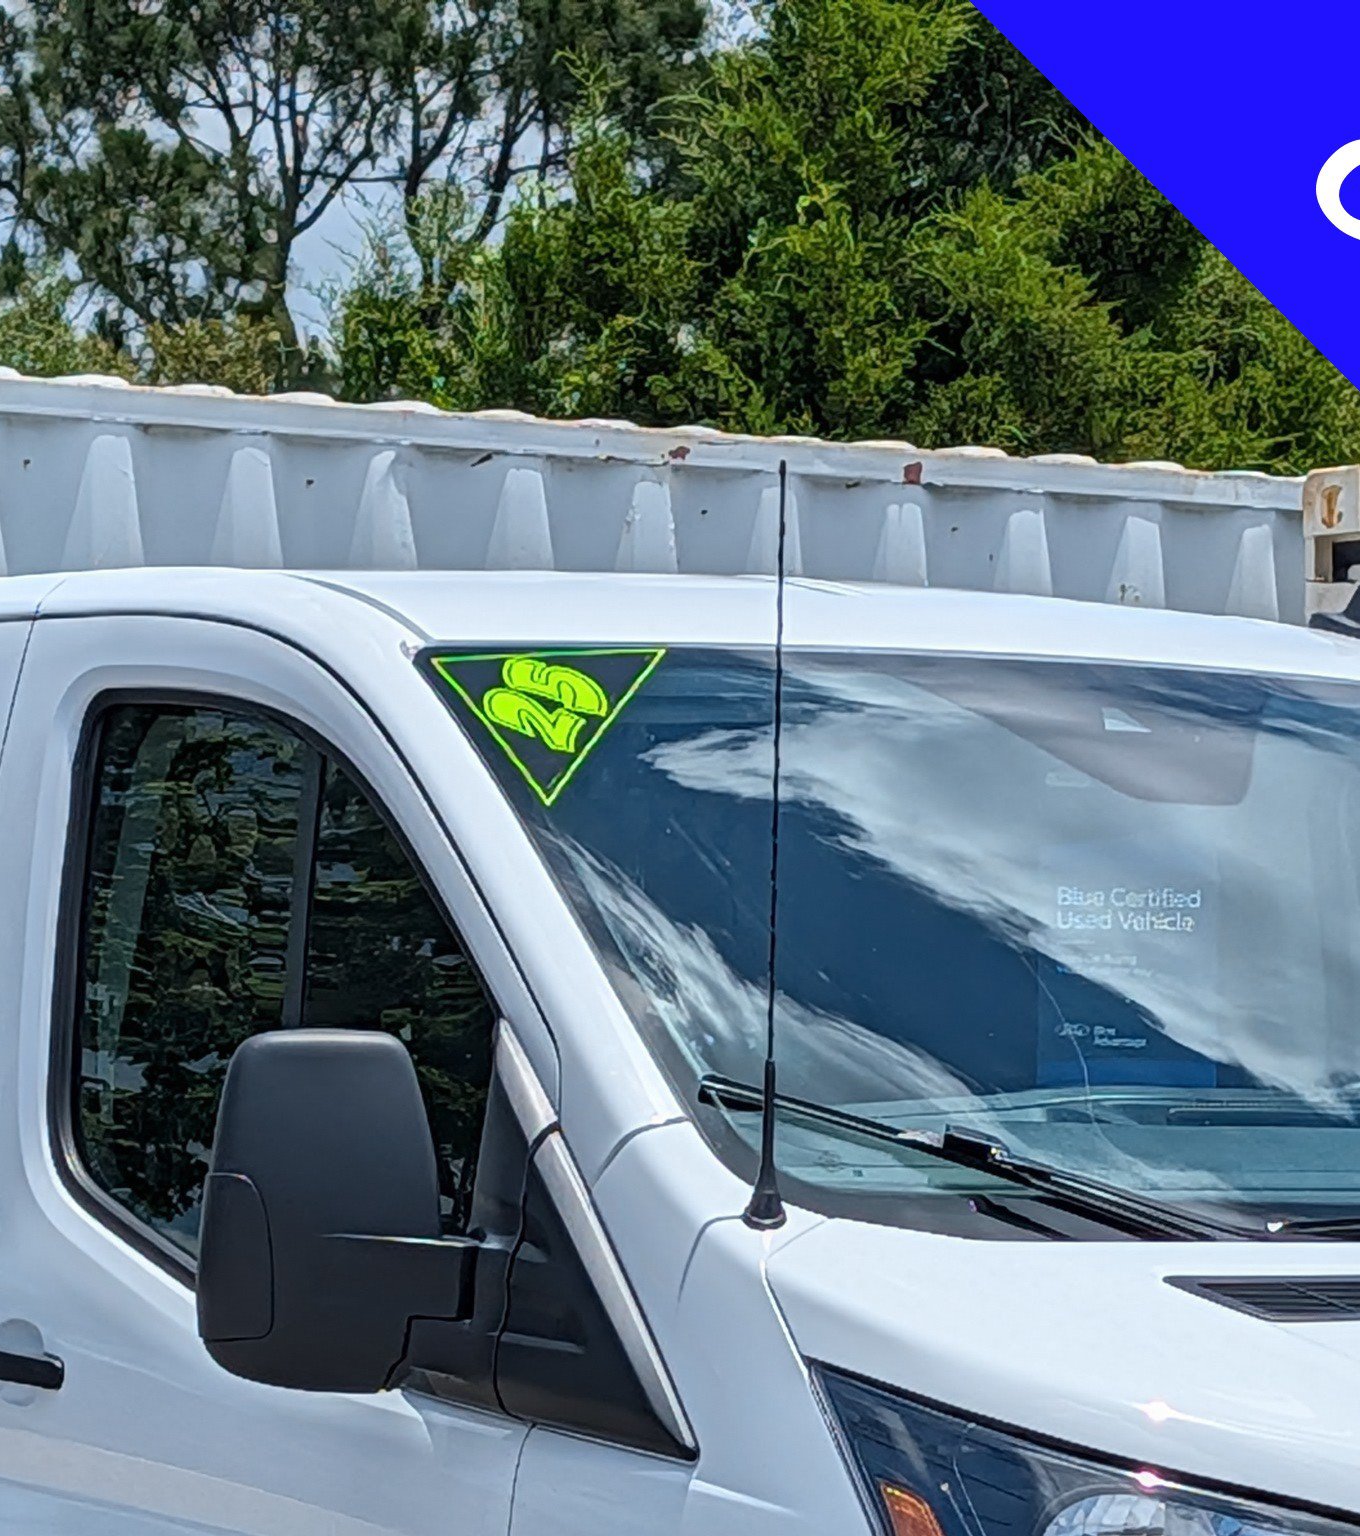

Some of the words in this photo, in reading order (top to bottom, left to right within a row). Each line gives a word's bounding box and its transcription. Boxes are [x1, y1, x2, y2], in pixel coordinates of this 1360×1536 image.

[482, 658, 608, 754] 25
[1110, 887, 1202, 908] Certified
[1056, 910, 1112, 930] Used
[1117, 911, 1196, 932] Vehicle
